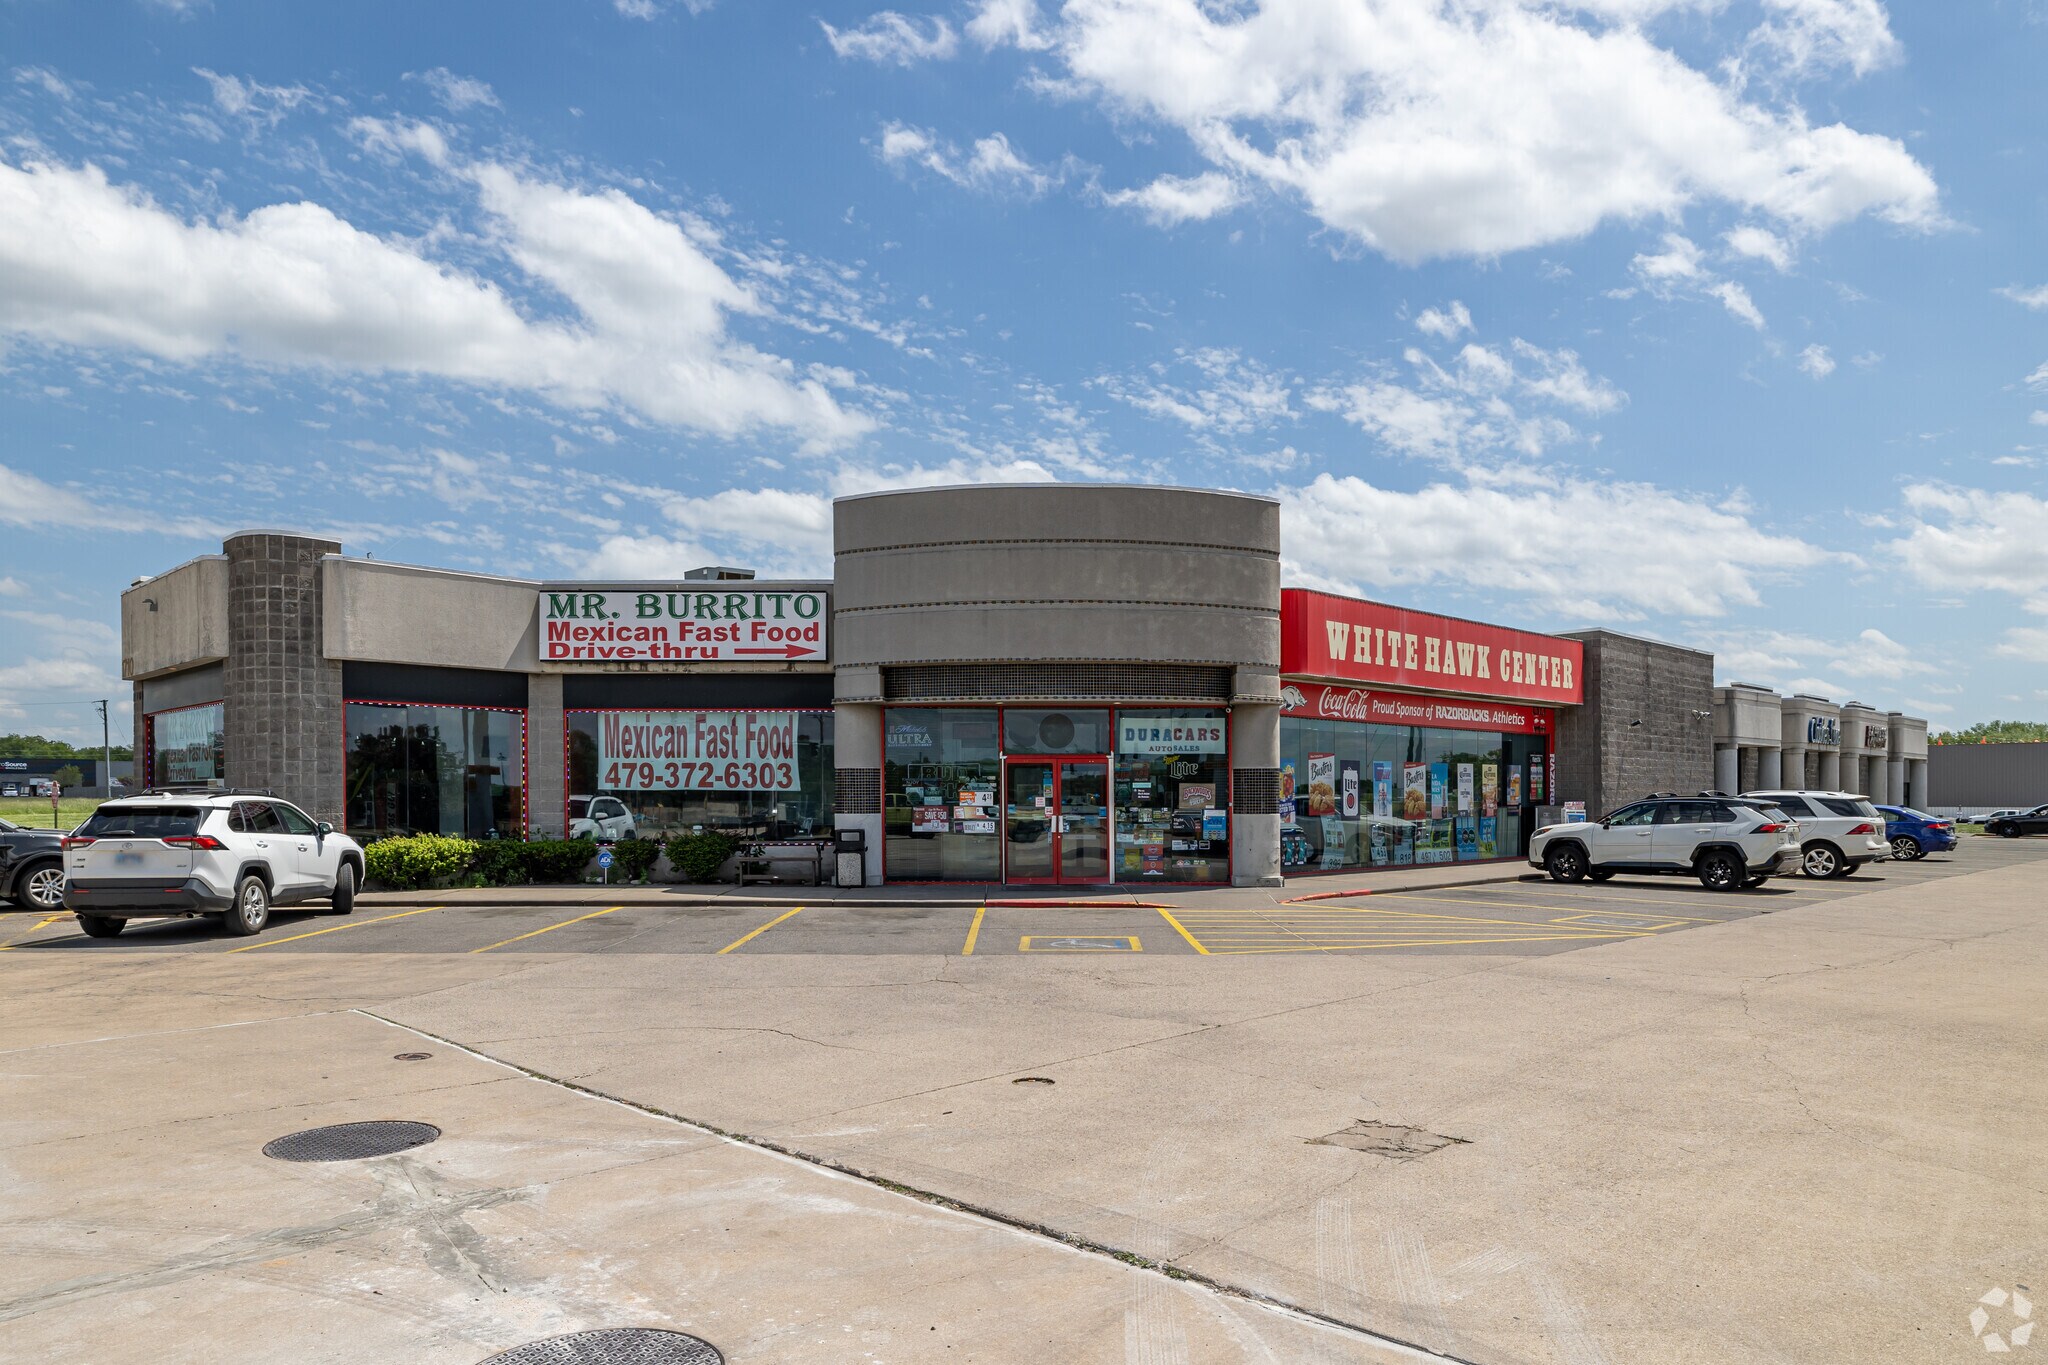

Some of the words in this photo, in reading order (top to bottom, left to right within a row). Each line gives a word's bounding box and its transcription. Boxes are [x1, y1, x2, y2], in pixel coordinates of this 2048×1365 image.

[546, 593, 621, 621] MR.
[635, 593, 821, 621] BURRITO
[547, 621, 668, 642] Mexican
[679, 621, 741, 642] Fast
[751, 621, 820, 642] Food
[548, 642, 719, 659] Drive-thru
[1325, 620, 1418, 671] WHITE
[1424, 636, 1491, 679] HAWK
[1499, 648, 1574, 690] CENTER
[1372, 700, 1395, 715] Proud
[1396, 702, 1425, 719] Sponsor
[1425, 704, 1434, 721] of
[1435, 705, 1489, 722] RAZORBACKS
[1491, 710, 1525, 726] Athletics
[604, 713, 688, 760] Mexican
[694, 713, 739, 760] Fast
[745, 713, 795, 760] Food
[887, 733, 933, 744] ULTRA
[604, 762, 794, 789] 479-372-6303
[1169, 761, 1199, 780] Lite
[1344, 778, 1357, 793] Lite
[924, 811, 937, 820] SAVE
[937, 811, 947, 820] $50
[1440, 850, 1451, 861] 502
